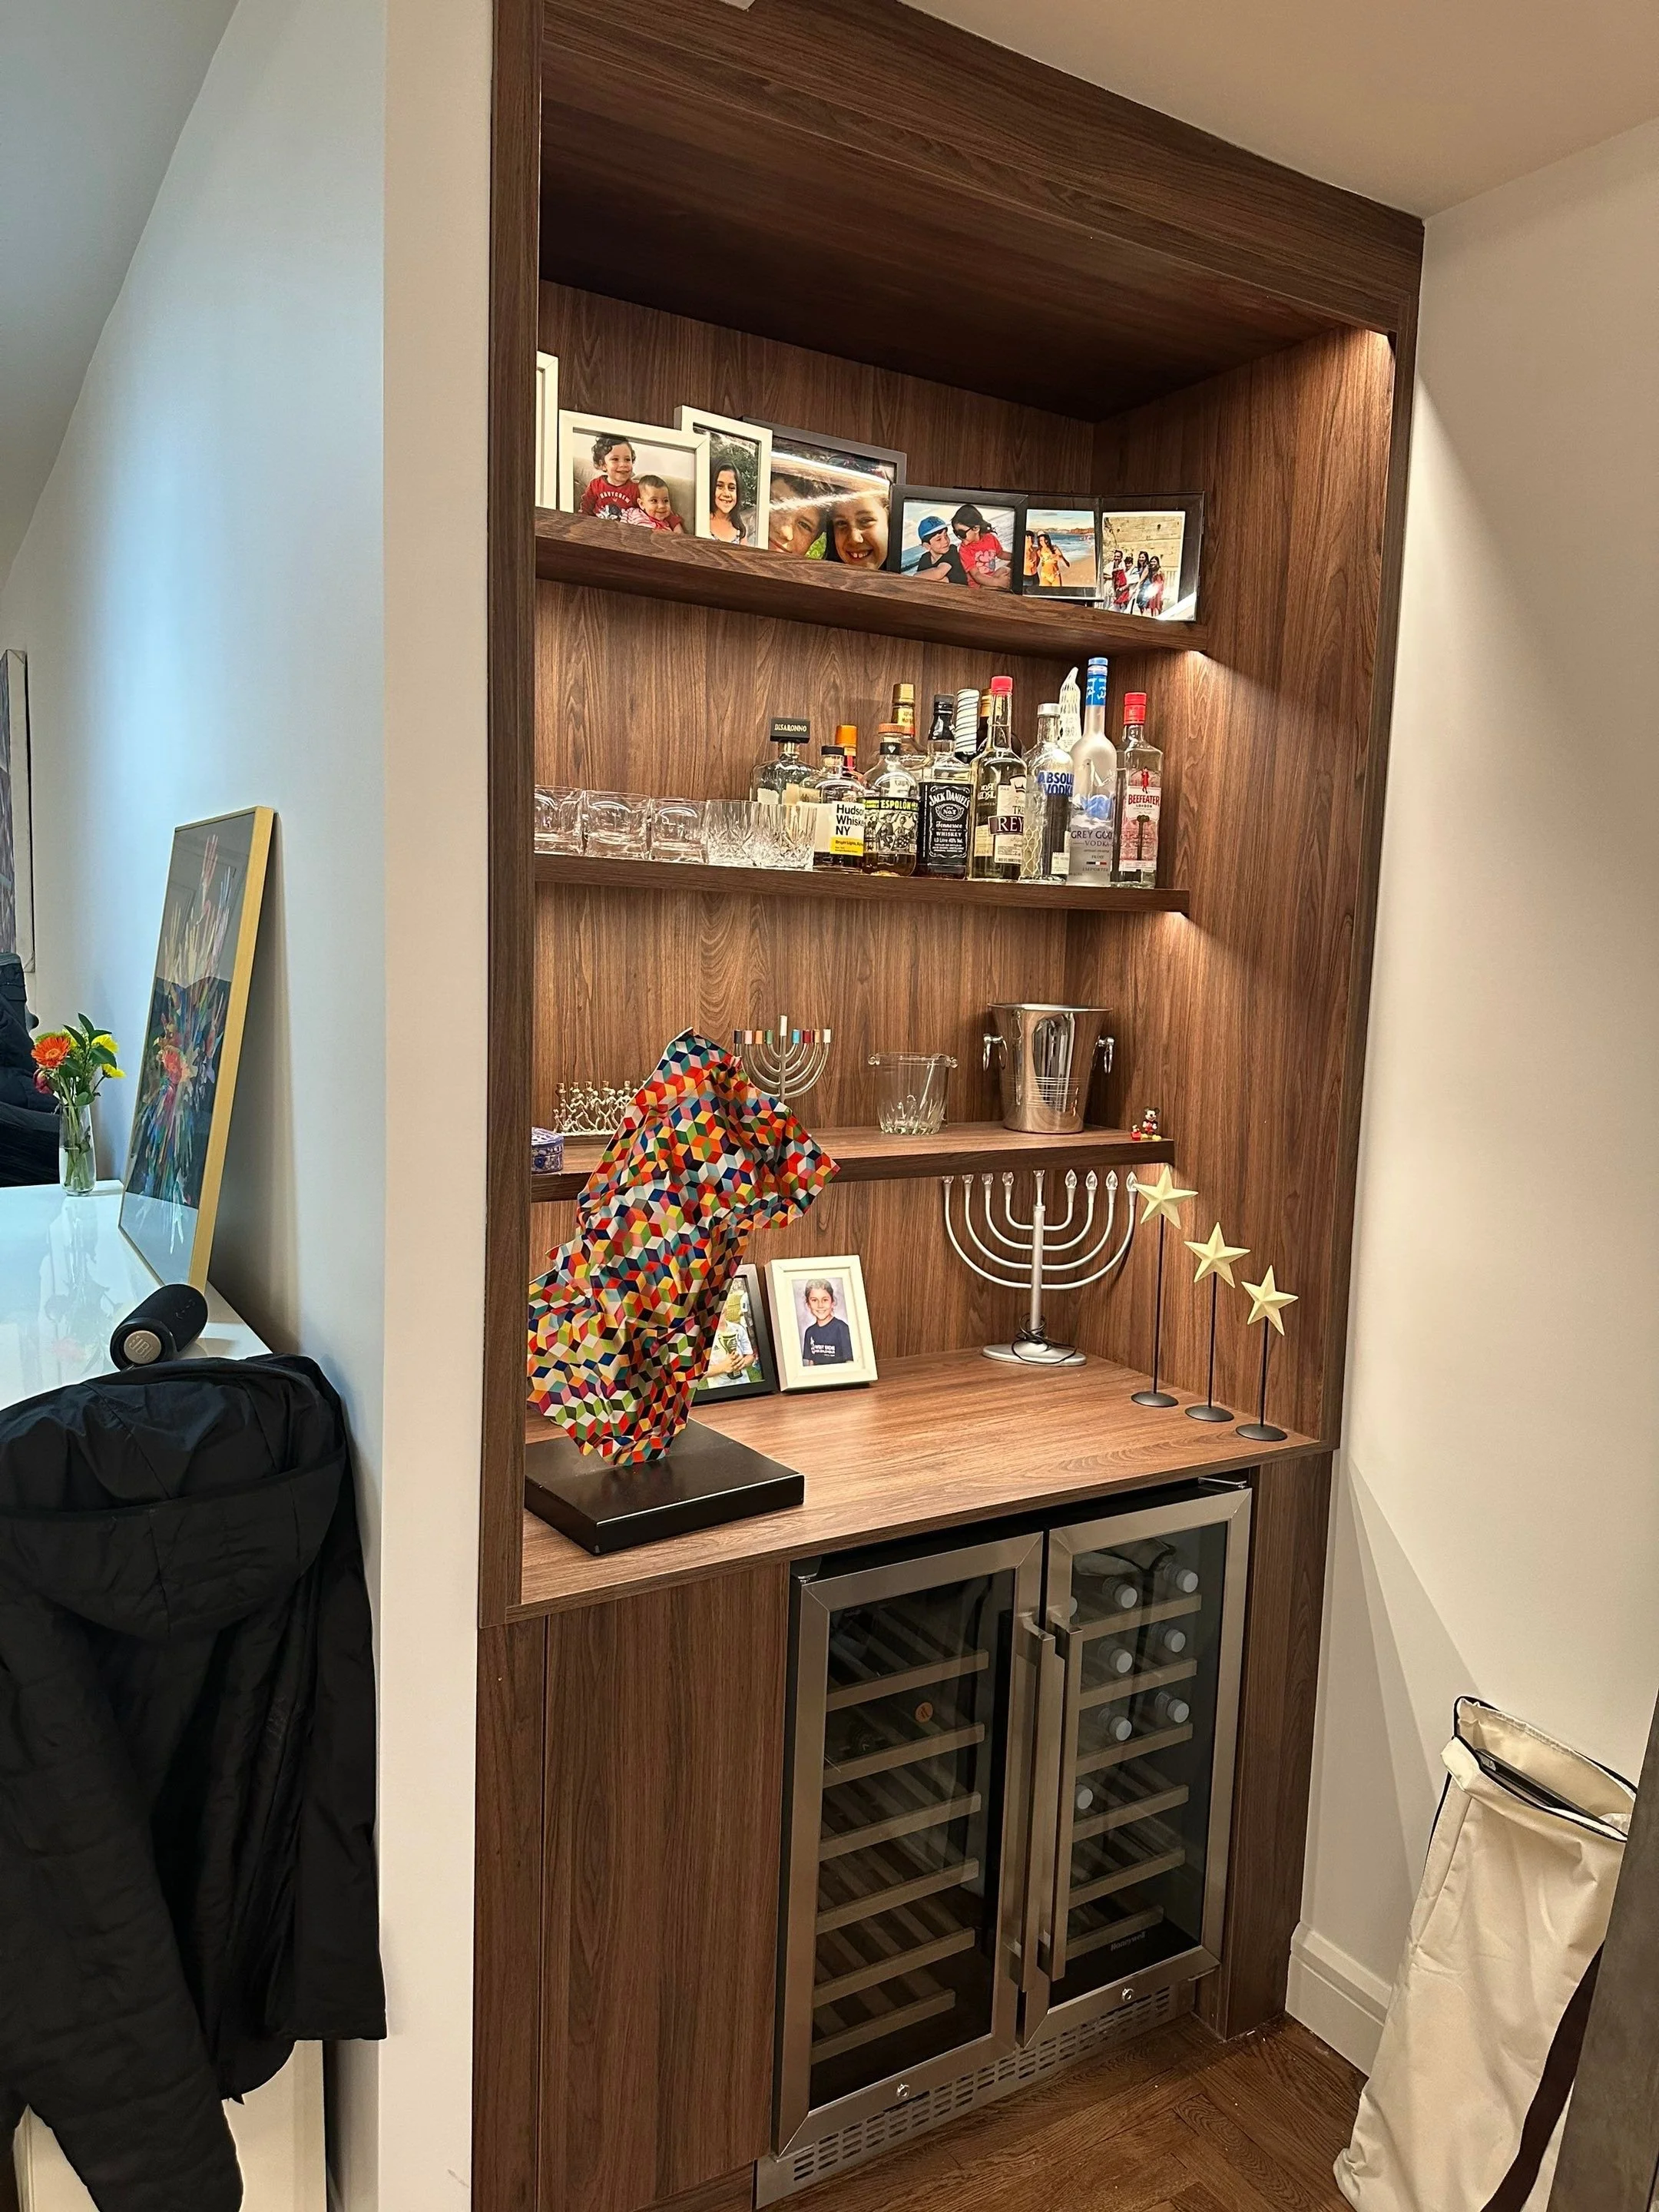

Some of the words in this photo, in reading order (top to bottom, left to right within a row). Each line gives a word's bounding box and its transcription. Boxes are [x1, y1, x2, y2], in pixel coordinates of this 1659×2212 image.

[774, 724, 807, 732] DISARONNO
[929, 793, 945, 806] JACK
[1128, 794, 1160, 807] BEEFEATER
[836, 826, 850, 836] NY
[1071, 830, 1093, 839] GREY
[128, 1335, 154, 1360] JBL
